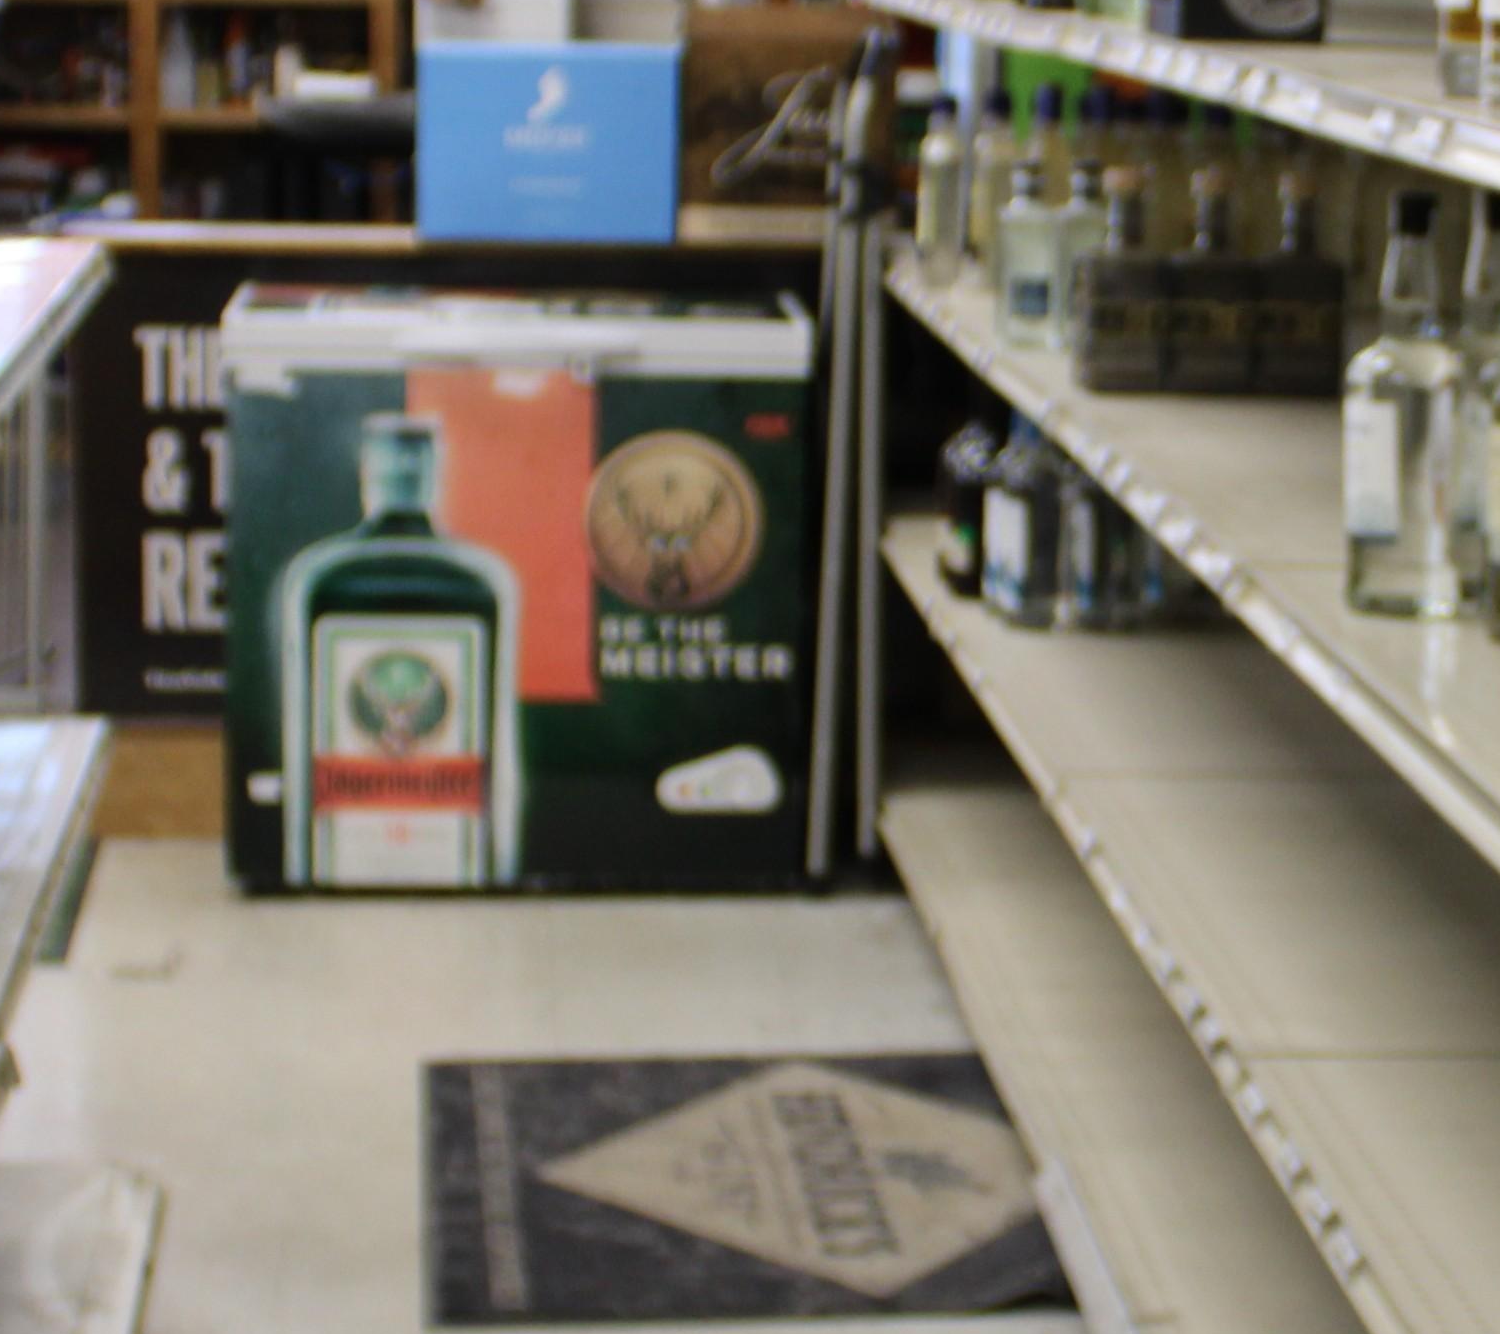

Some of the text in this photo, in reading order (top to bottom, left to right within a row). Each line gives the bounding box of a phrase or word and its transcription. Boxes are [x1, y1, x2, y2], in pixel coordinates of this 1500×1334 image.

[140, 428, 193, 513] &
[658, 616, 731, 646] THE
[597, 643, 794, 681] MEISTER
